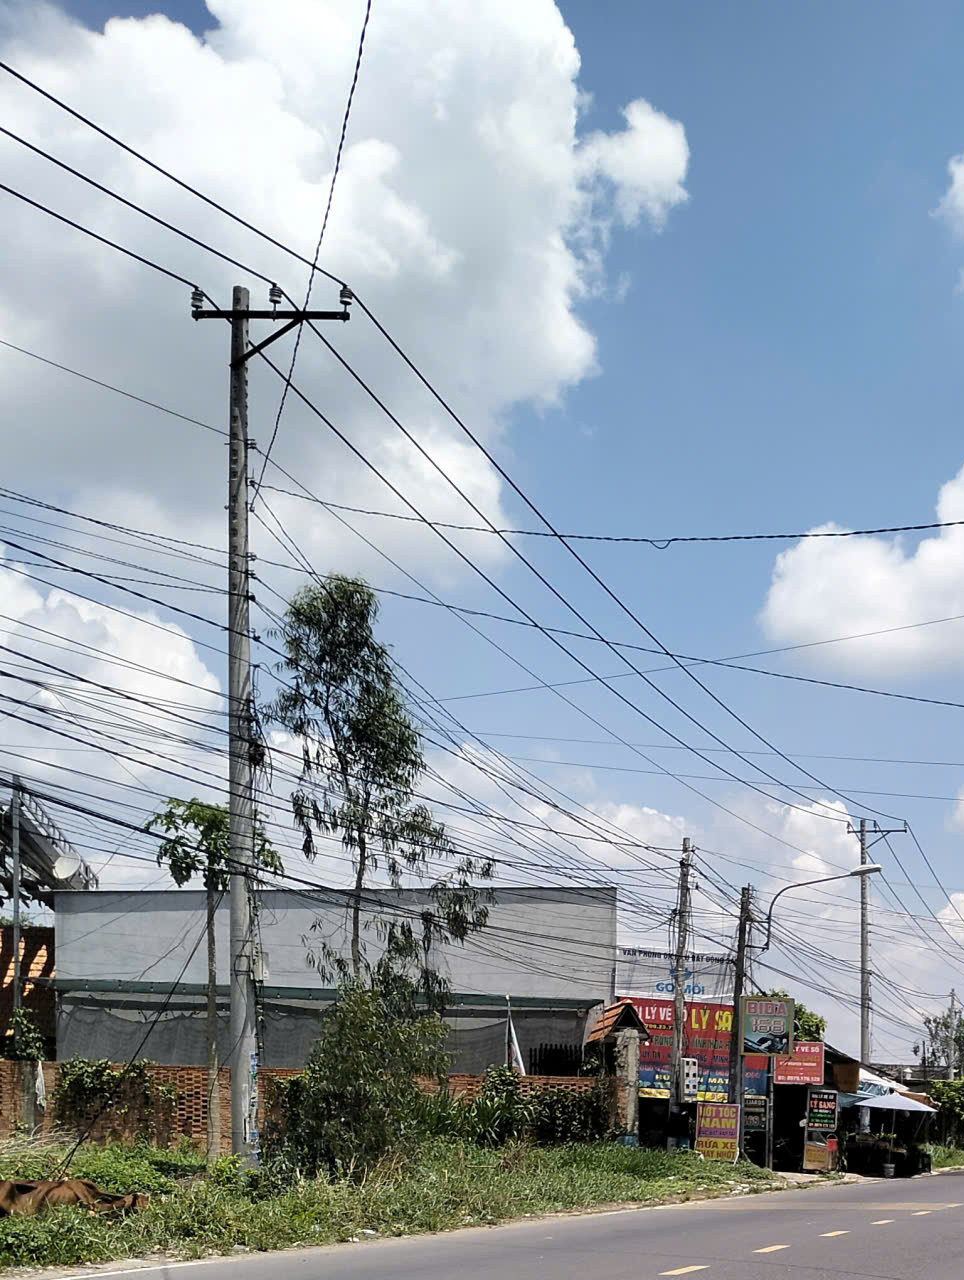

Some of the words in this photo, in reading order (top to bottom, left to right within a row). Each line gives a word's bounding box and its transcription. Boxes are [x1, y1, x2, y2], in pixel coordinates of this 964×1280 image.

[747, 1001, 787, 1016] BIDA
[690, 1005, 710, 1030] LÝ
[701, 1117, 737, 1129] NAM
